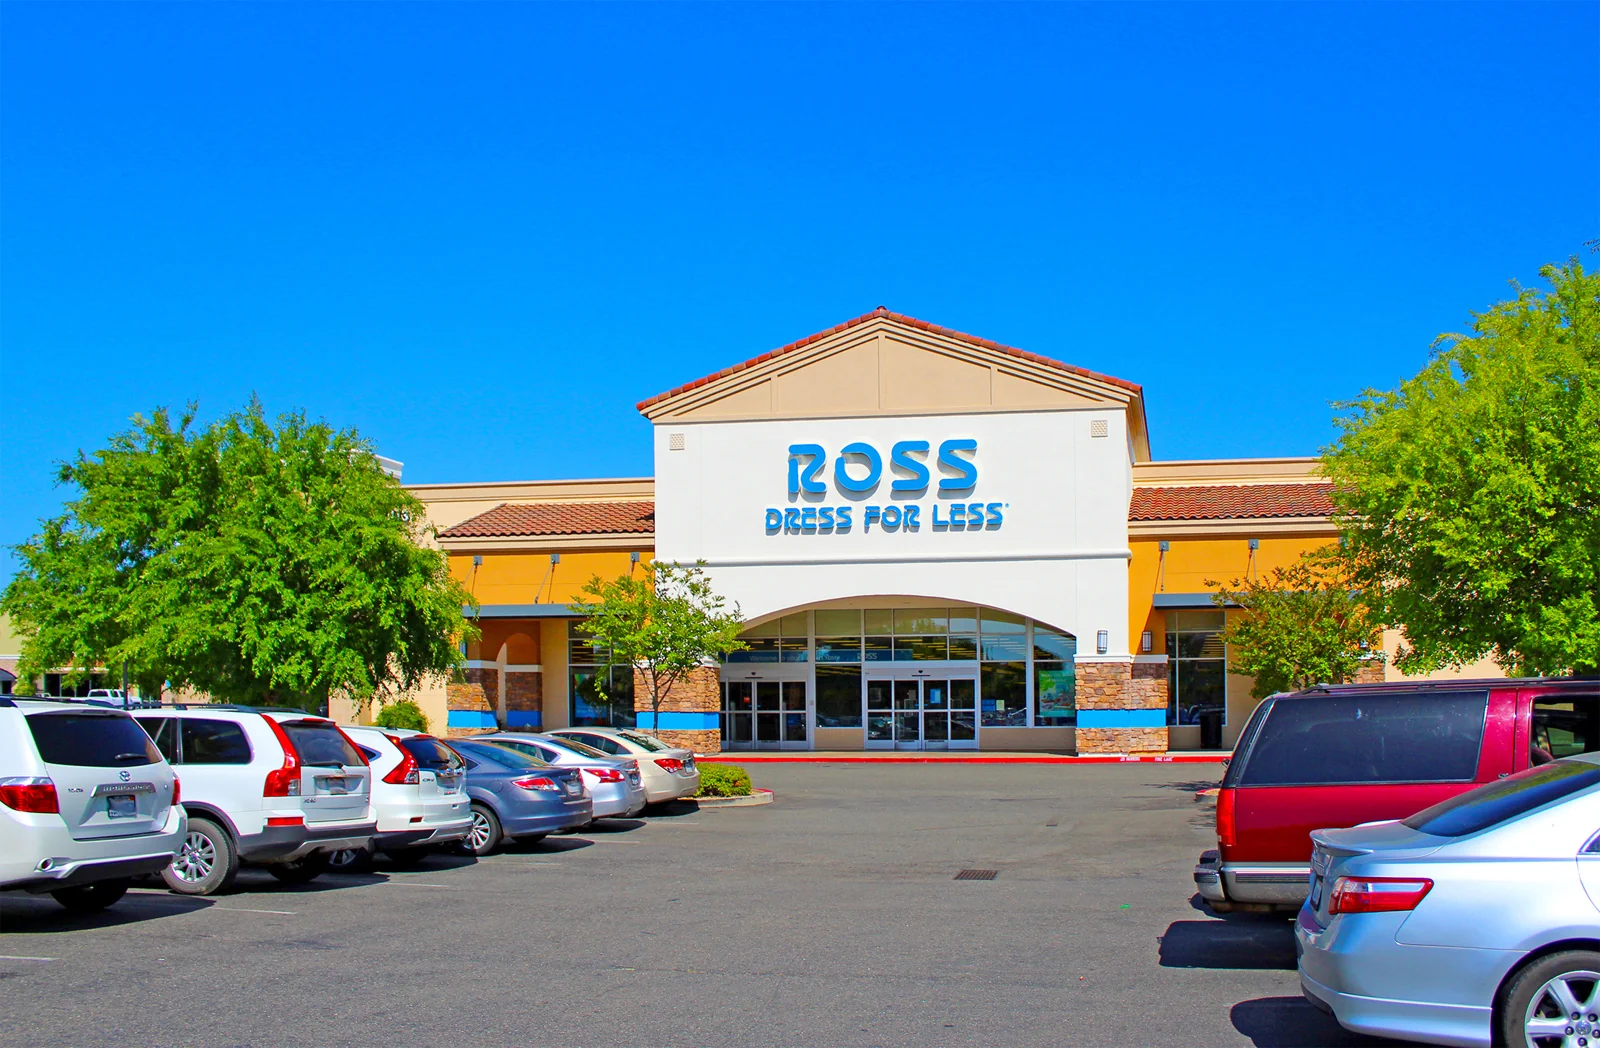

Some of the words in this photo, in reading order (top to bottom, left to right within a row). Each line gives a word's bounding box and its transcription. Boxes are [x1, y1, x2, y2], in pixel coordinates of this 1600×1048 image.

[787, 438, 978, 496] ROSS
[765, 506, 853, 533] DRESS
[863, 504, 921, 531] FOR
[931, 502, 1003, 529] LESS
